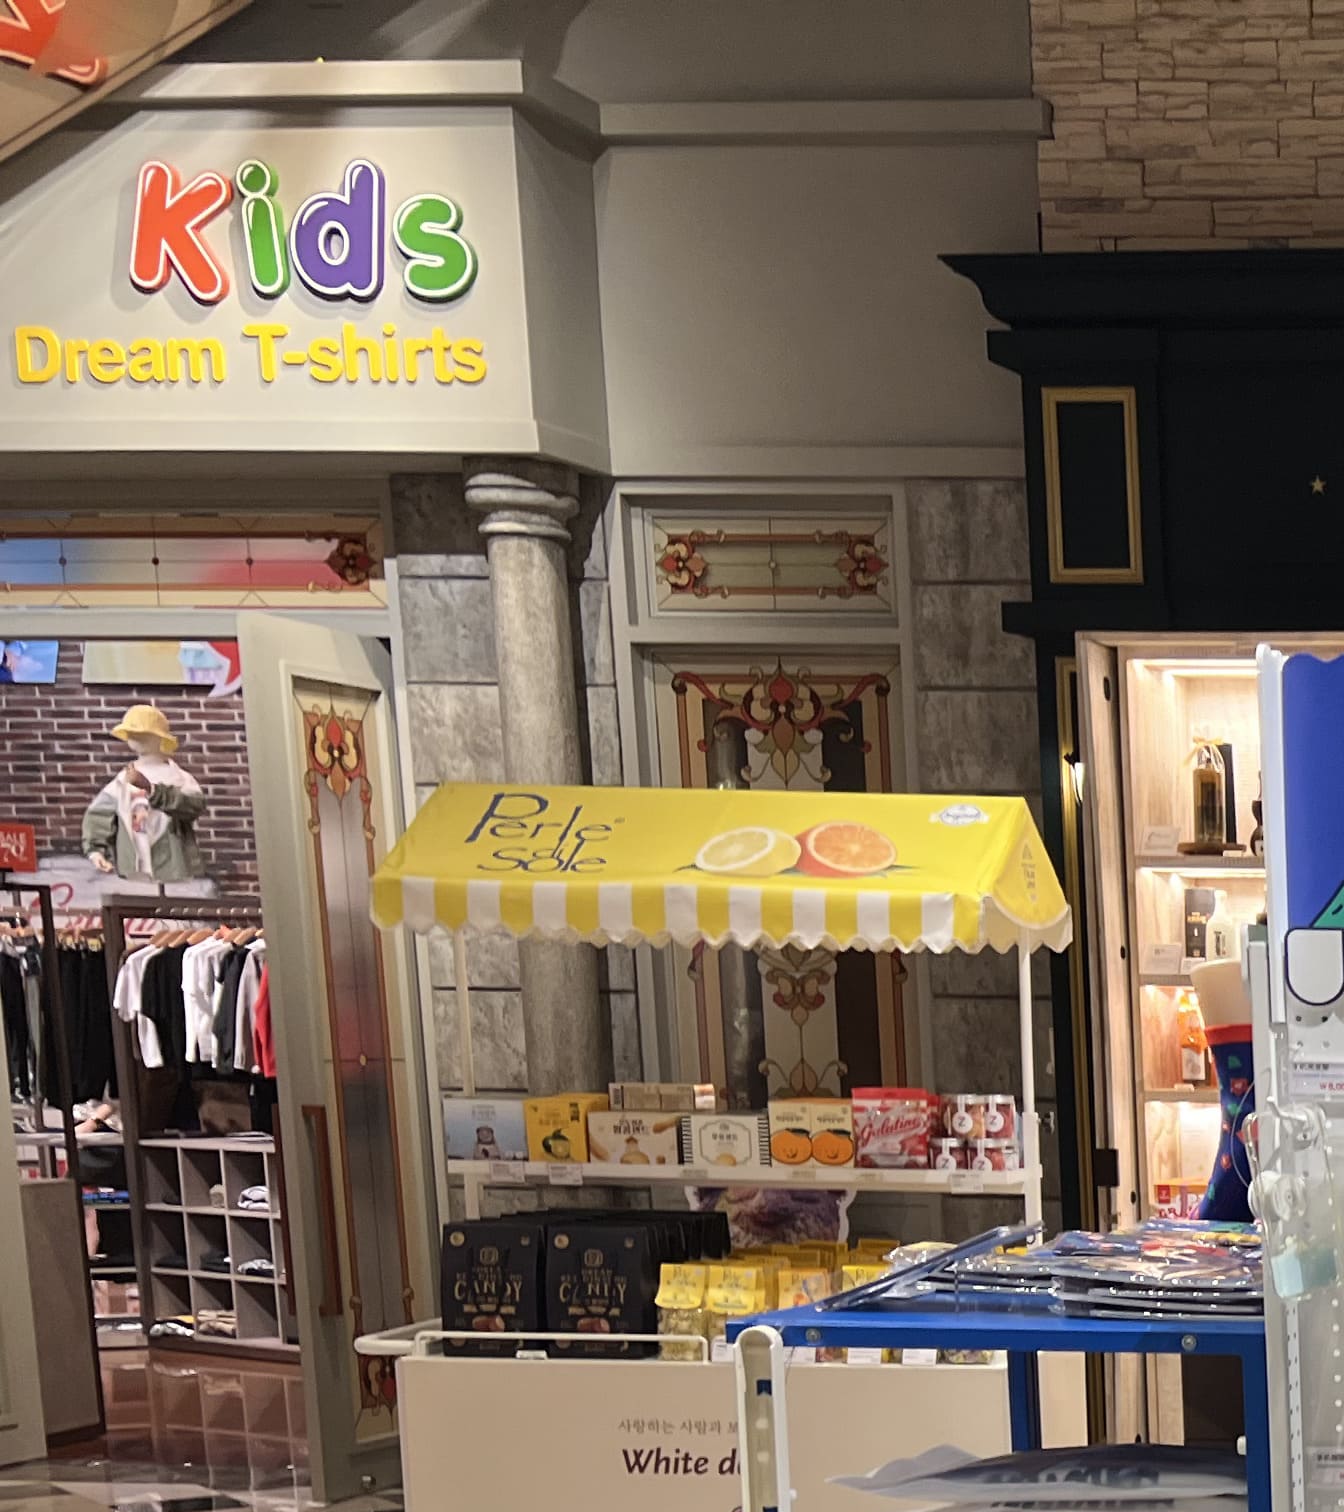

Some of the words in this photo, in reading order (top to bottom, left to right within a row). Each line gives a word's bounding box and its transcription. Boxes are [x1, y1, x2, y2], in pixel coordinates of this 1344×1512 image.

[129, 159, 478, 305] Kids
[14, 324, 226, 386] Dream
[243, 322, 487, 386] T-shirts
[464, 792, 612, 845] Perle
[622, 1446, 709, 1475] White
